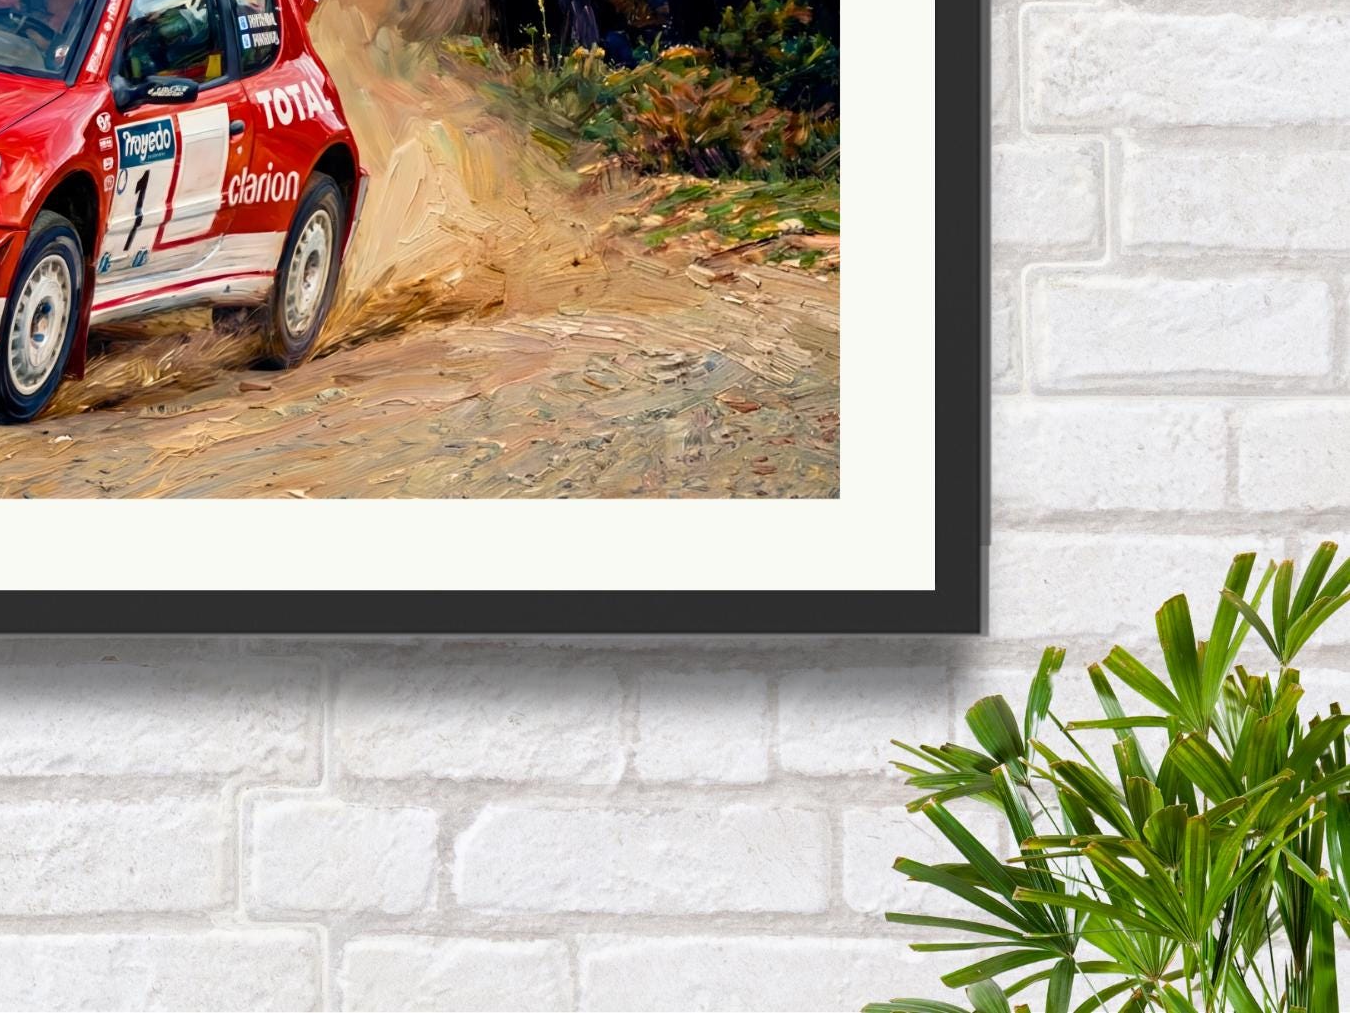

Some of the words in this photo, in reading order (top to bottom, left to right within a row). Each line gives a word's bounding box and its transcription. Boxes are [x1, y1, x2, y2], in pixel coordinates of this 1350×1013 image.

[255, 78, 334, 129] TOTAL
[228, 161, 300, 207] clarion
[123, 169, 150, 252] 1
